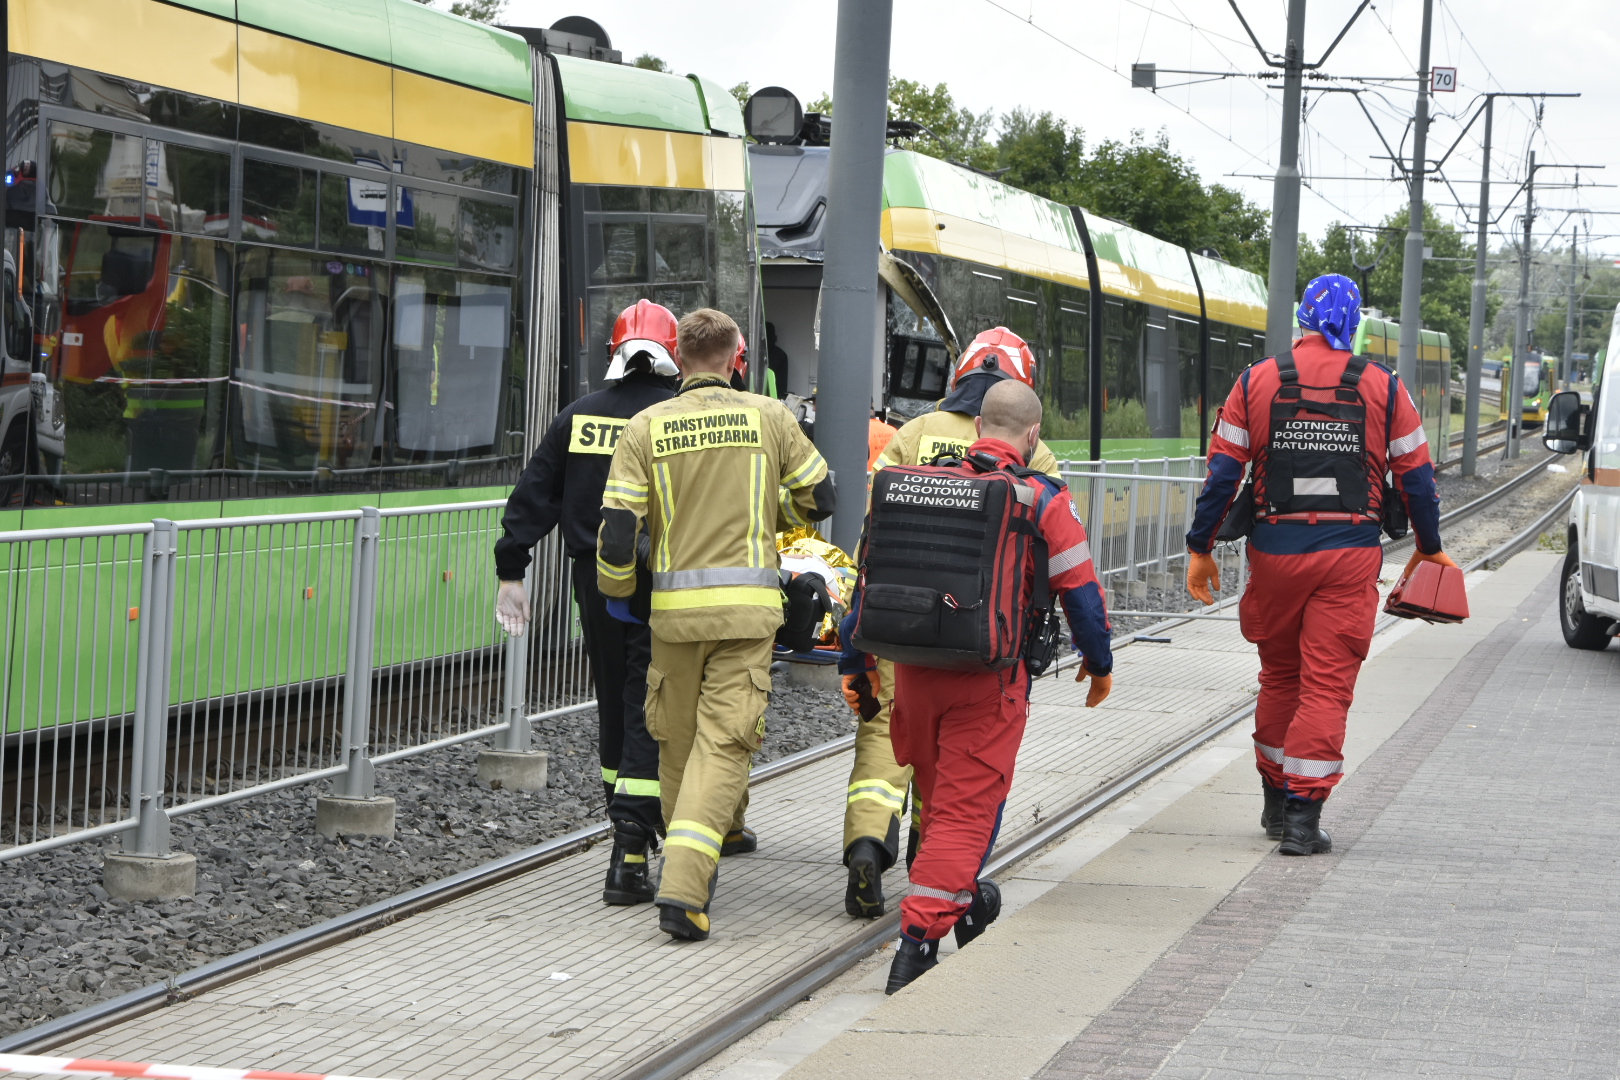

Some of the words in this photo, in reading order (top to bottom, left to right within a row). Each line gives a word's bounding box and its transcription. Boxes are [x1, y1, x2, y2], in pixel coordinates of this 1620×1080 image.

[1435, 72, 1452, 86] 70
[663, 413, 749, 435] PAŃSTWOWA
[1285, 421, 1350, 432] LOTNICZE
[655, 434, 698, 453] STRAŻ
[699, 429, 759, 447] POŻARNA
[1274, 431, 1359, 443] POGOTOWIE
[1272, 441, 1360, 453] RATUNKOWE
[903, 474, 973, 487] LOTNICZE
[889, 482, 981, 498] POGOTOWIE
[885, 493, 980, 509] RATUNKOWE
